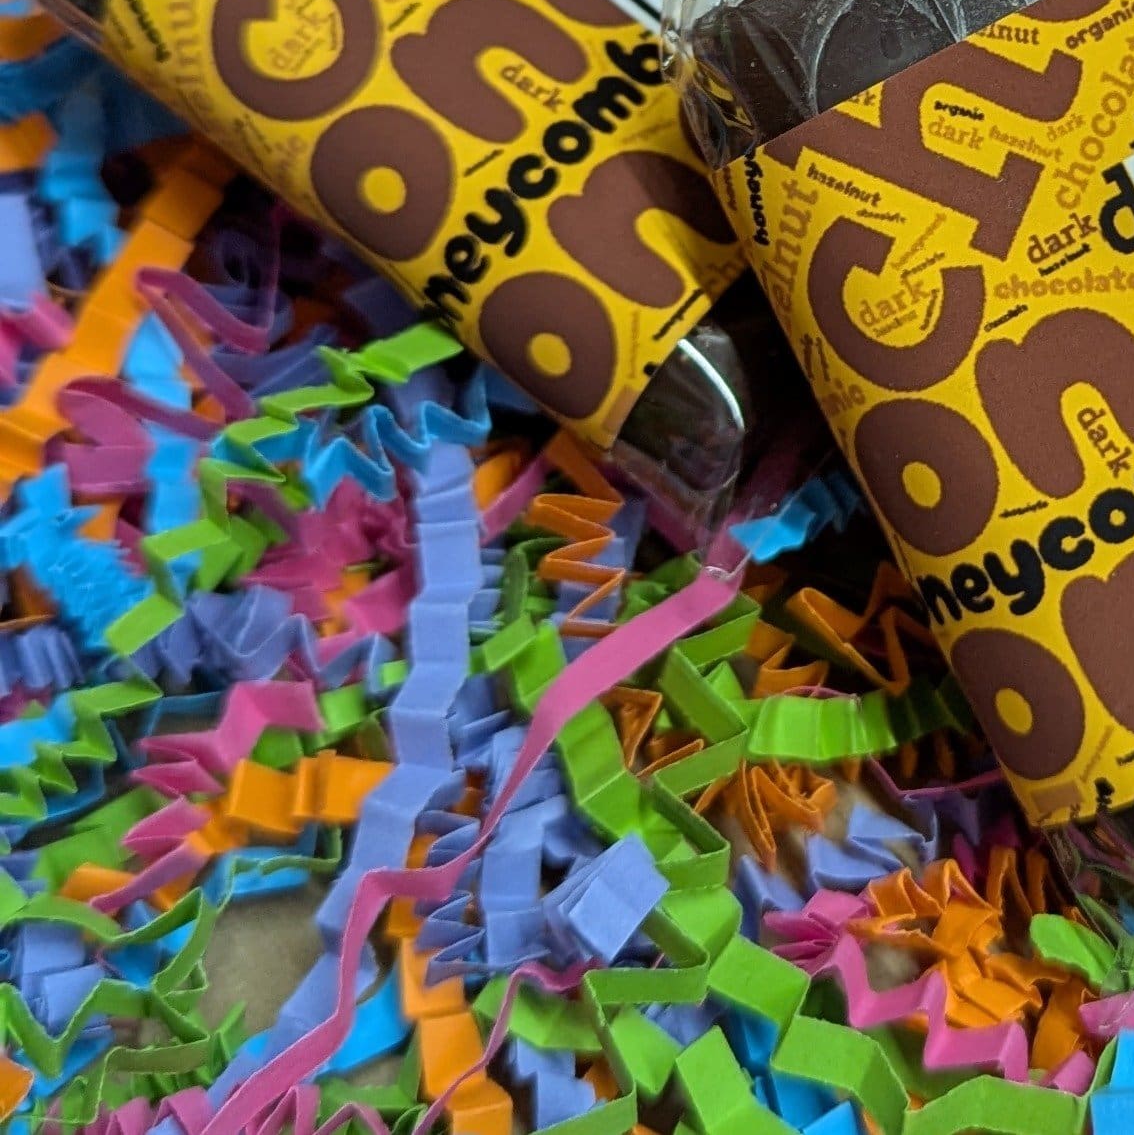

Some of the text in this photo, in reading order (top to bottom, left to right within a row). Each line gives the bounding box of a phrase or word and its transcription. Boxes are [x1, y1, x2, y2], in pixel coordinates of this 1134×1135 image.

[500, 64, 564, 113] dark
[933, 99, 985, 122] organic
[926, 116, 986, 151] dark
[988, 124, 1064, 163] hazelnut
[806, 162, 883, 208] hazelnut
[1026, 212, 1100, 265] dark
[858, 274, 931, 328] dark
[1077, 405, 1134, 479] dark
